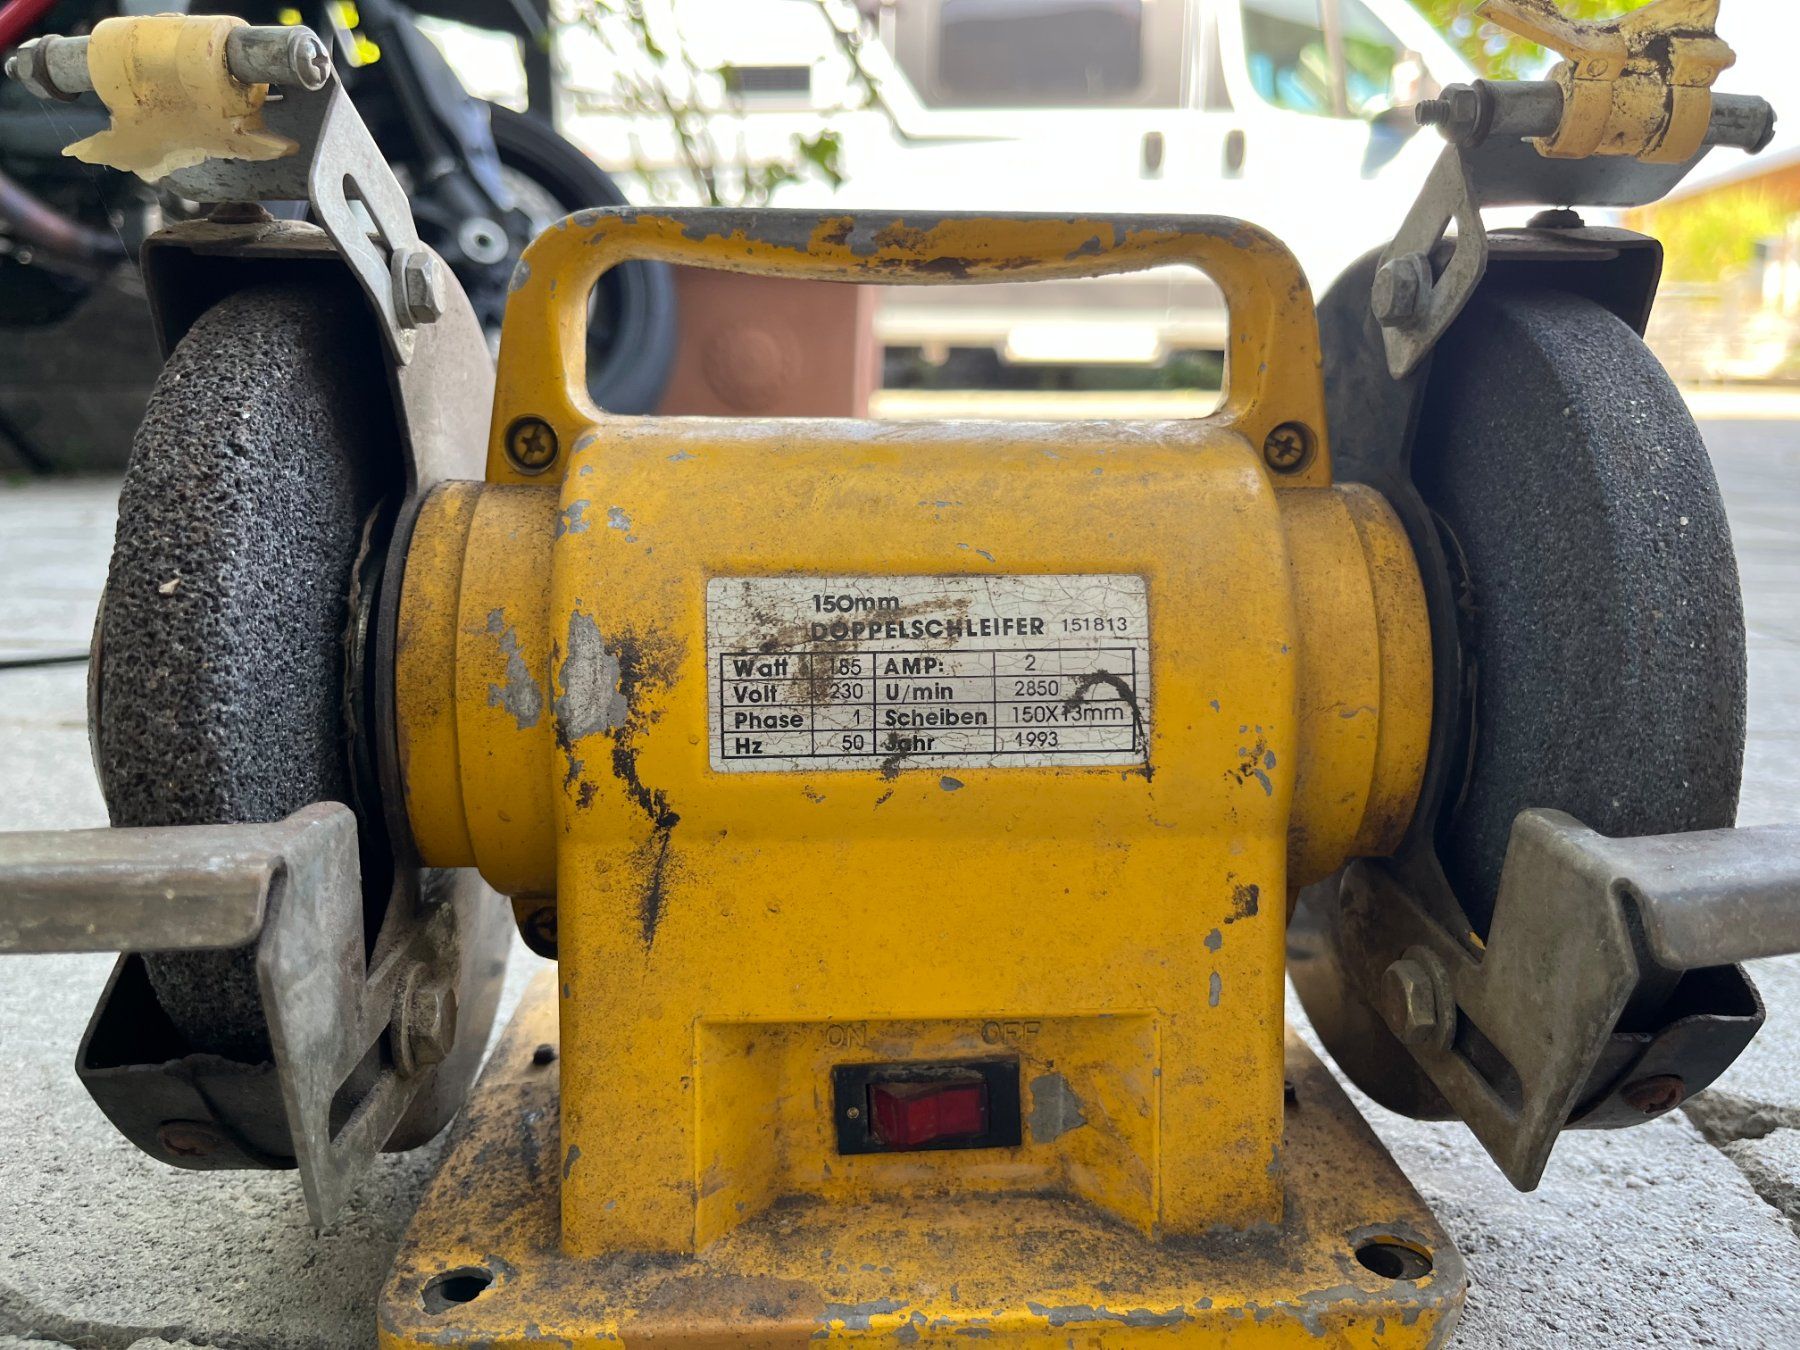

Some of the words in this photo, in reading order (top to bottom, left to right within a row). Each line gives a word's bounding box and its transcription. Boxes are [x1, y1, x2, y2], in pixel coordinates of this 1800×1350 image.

[813, 594, 899, 612] 150mm
[812, 617, 1044, 640] DOPPELSCHLEIFER
[1062, 617, 1127, 632] 151813
[733, 658, 788, 677] Watt
[831, 658, 862, 675] 185
[884, 658, 944, 675] AMP:
[1025, 655, 1036, 671] 2
[733, 684, 777, 703] Volt
[830, 684, 863, 700] 230
[886, 683, 954, 702] U/min
[1015, 681, 1059, 697] 2850
[734, 712, 804, 729] Phase
[853, 709, 860, 725] 1
[885, 708, 987, 725] Scheiben
[735, 737, 763, 754] Hz
[842, 735, 863, 750] 50
[885, 735, 935, 751] Jahr
[1015, 731, 1058, 747] 1993
[826, 1024, 867, 1048] ON
[982, 1021, 1040, 1044] OFF
